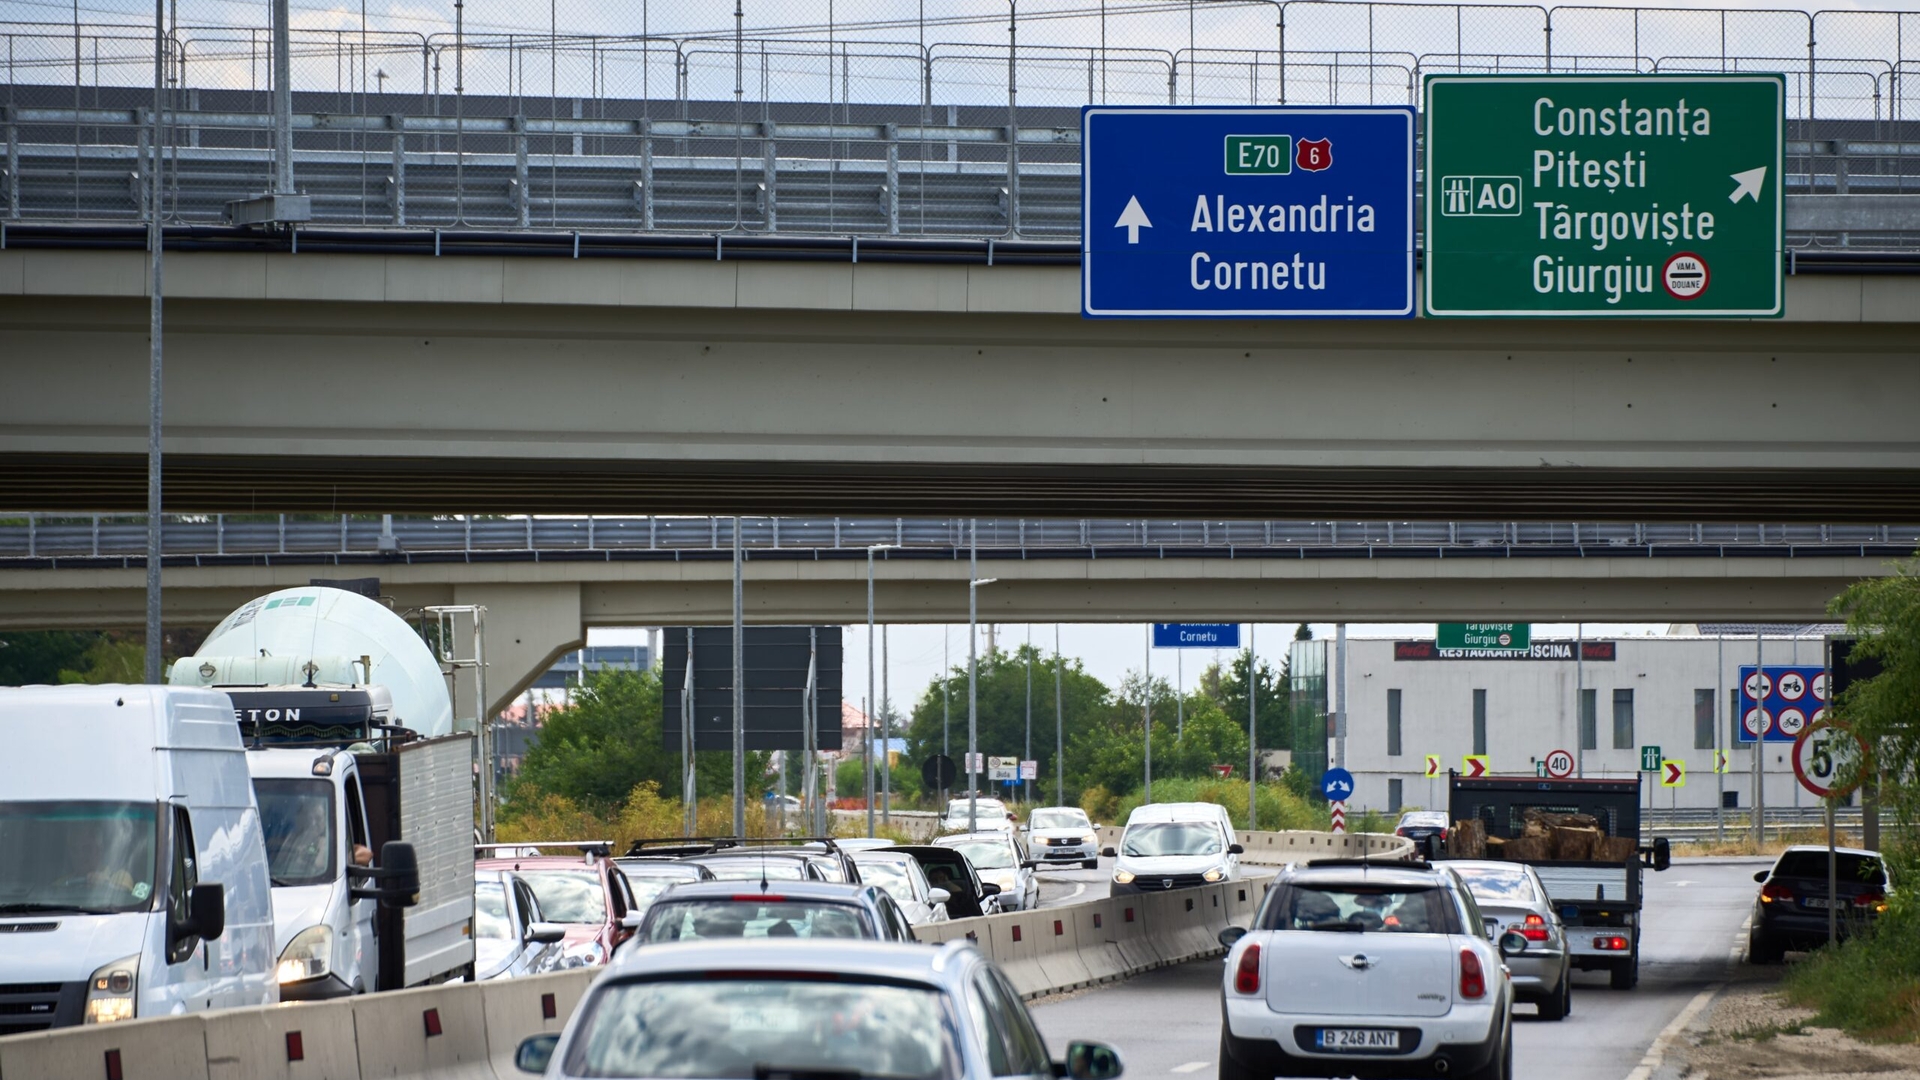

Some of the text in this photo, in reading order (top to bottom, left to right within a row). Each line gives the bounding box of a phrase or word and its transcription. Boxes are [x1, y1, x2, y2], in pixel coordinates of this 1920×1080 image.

[1534, 97, 1711, 142] Constanța
[1238, 142, 1280, 168] E70
[1309, 147, 1320, 165] 6
[1534, 150, 1646, 195] Pitești
[1190, 194, 1375, 233] Alexandria
[1533, 201, 1715, 251] Târgoviște
[1190, 251, 1326, 291] Cornetu
[1676, 262, 1696, 270] VAMA
[1533, 254, 1653, 304] Giurgiu
[1672, 280, 1701, 289] DOUANE
[1180, 630, 1217, 642] Cornetu
[1464, 633, 1497, 647] Giurgiu
[1551, 757, 1567, 771] 40
[1325, 1031, 1395, 1046] B 248 ANT
